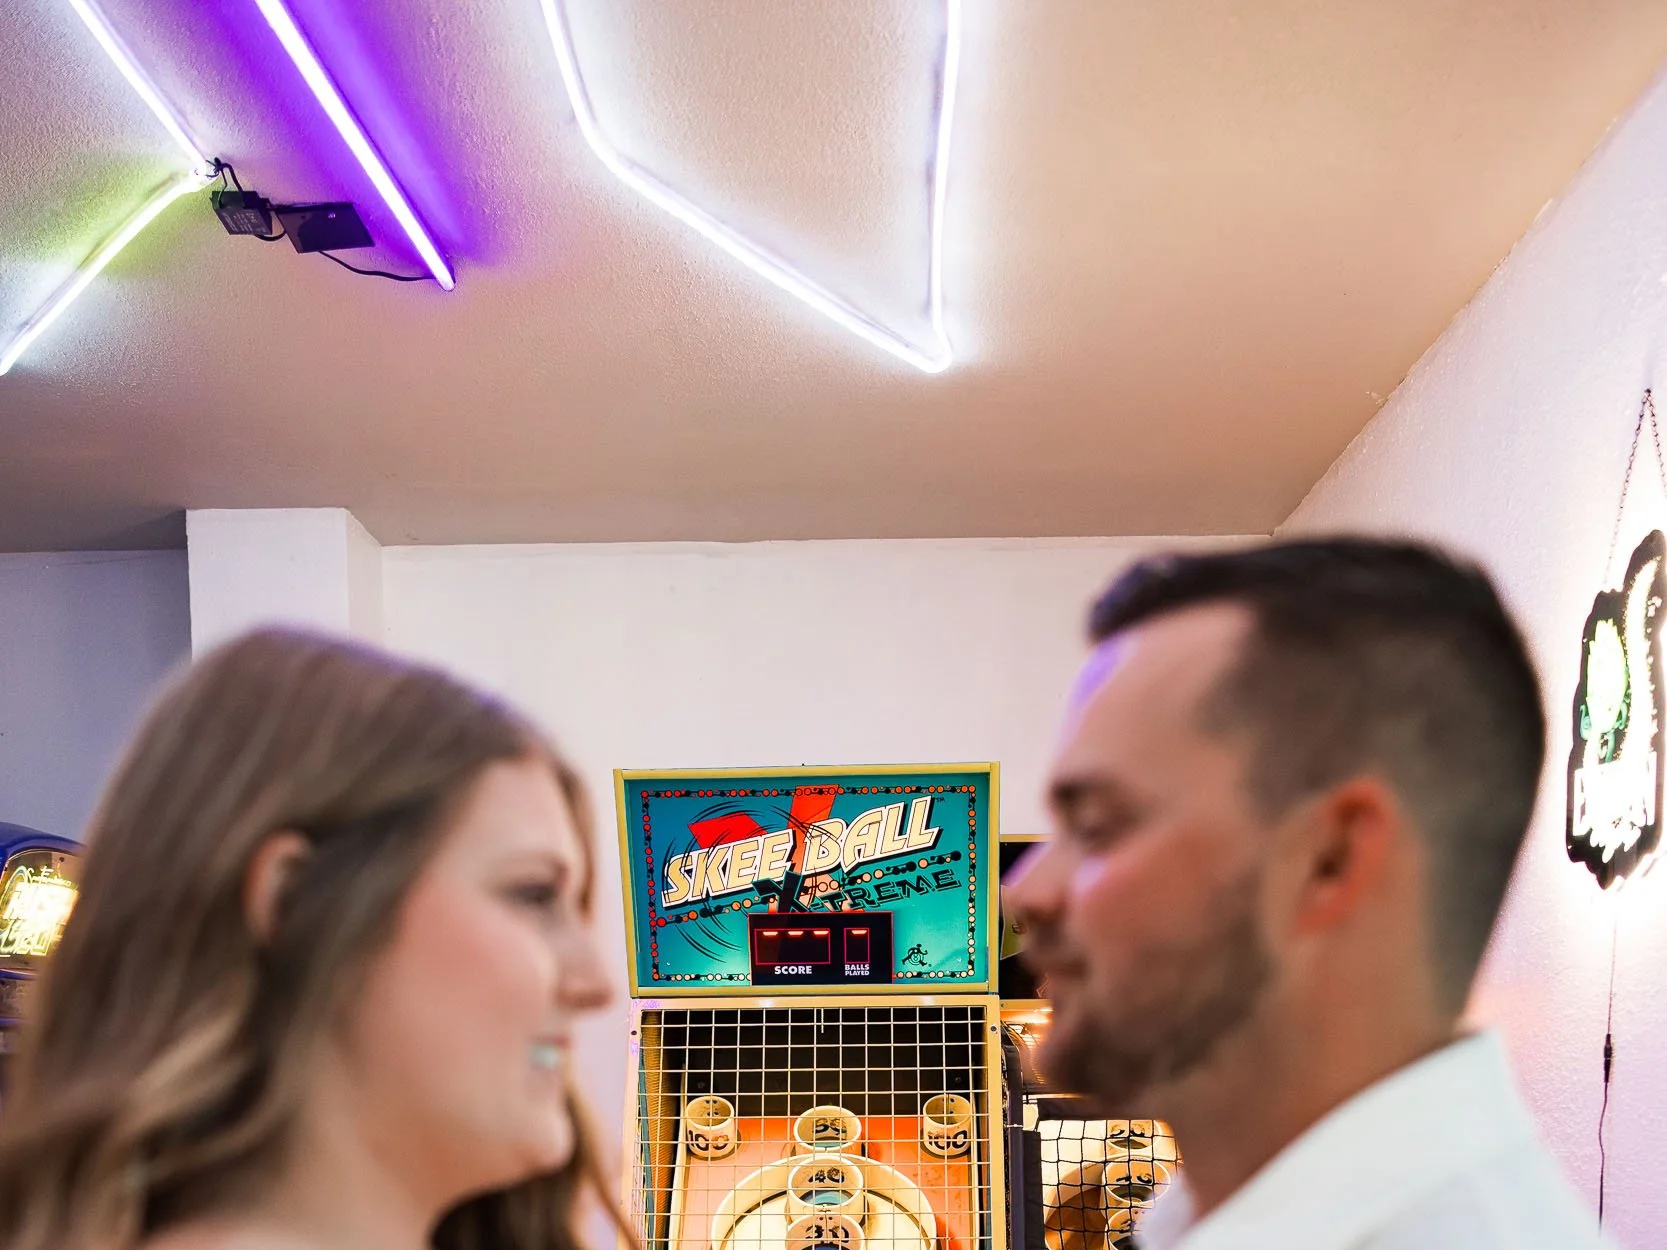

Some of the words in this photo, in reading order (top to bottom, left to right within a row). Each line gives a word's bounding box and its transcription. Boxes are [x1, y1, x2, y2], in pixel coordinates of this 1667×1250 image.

[662, 828, 796, 908] SKEE
[802, 796, 941, 876] BALL
[774, 965, 813, 975] SCORE
[688, 1129, 729, 1151] 100
[928, 1129, 968, 1150] 100
[808, 1167, 845, 1183] 40
[805, 1224, 850, 1243] 30
